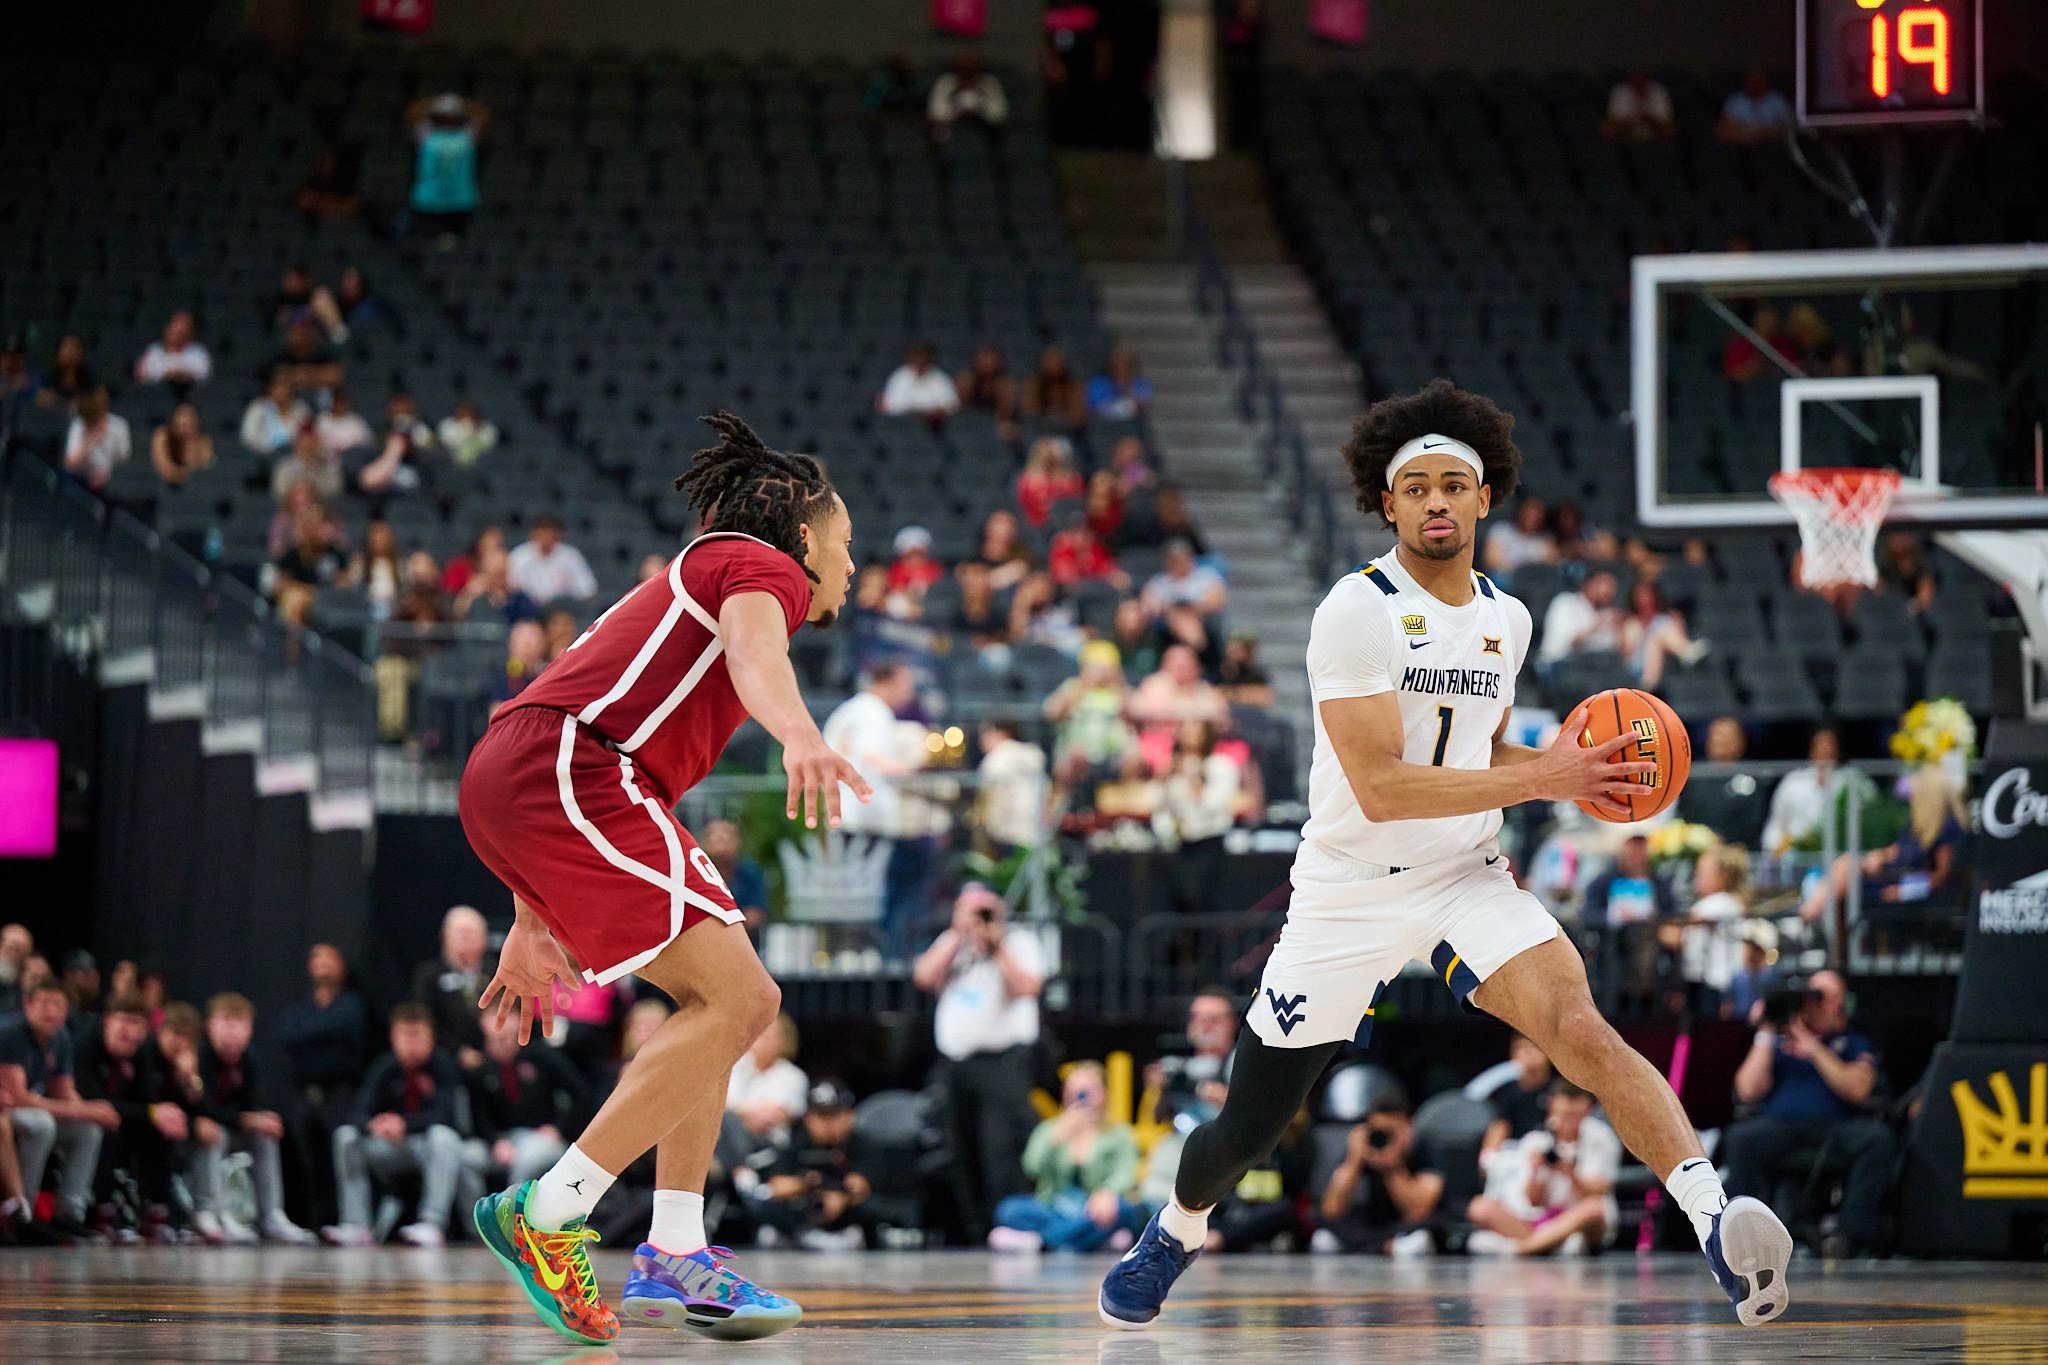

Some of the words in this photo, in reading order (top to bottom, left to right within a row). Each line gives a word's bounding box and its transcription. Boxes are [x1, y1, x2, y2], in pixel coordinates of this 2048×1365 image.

[1871, 7, 1950, 98] 19
[1400, 666, 1500, 699] MOUNTAINEERS
[1431, 705, 1455, 766] 1
[1265, 987, 1308, 1038] WV
